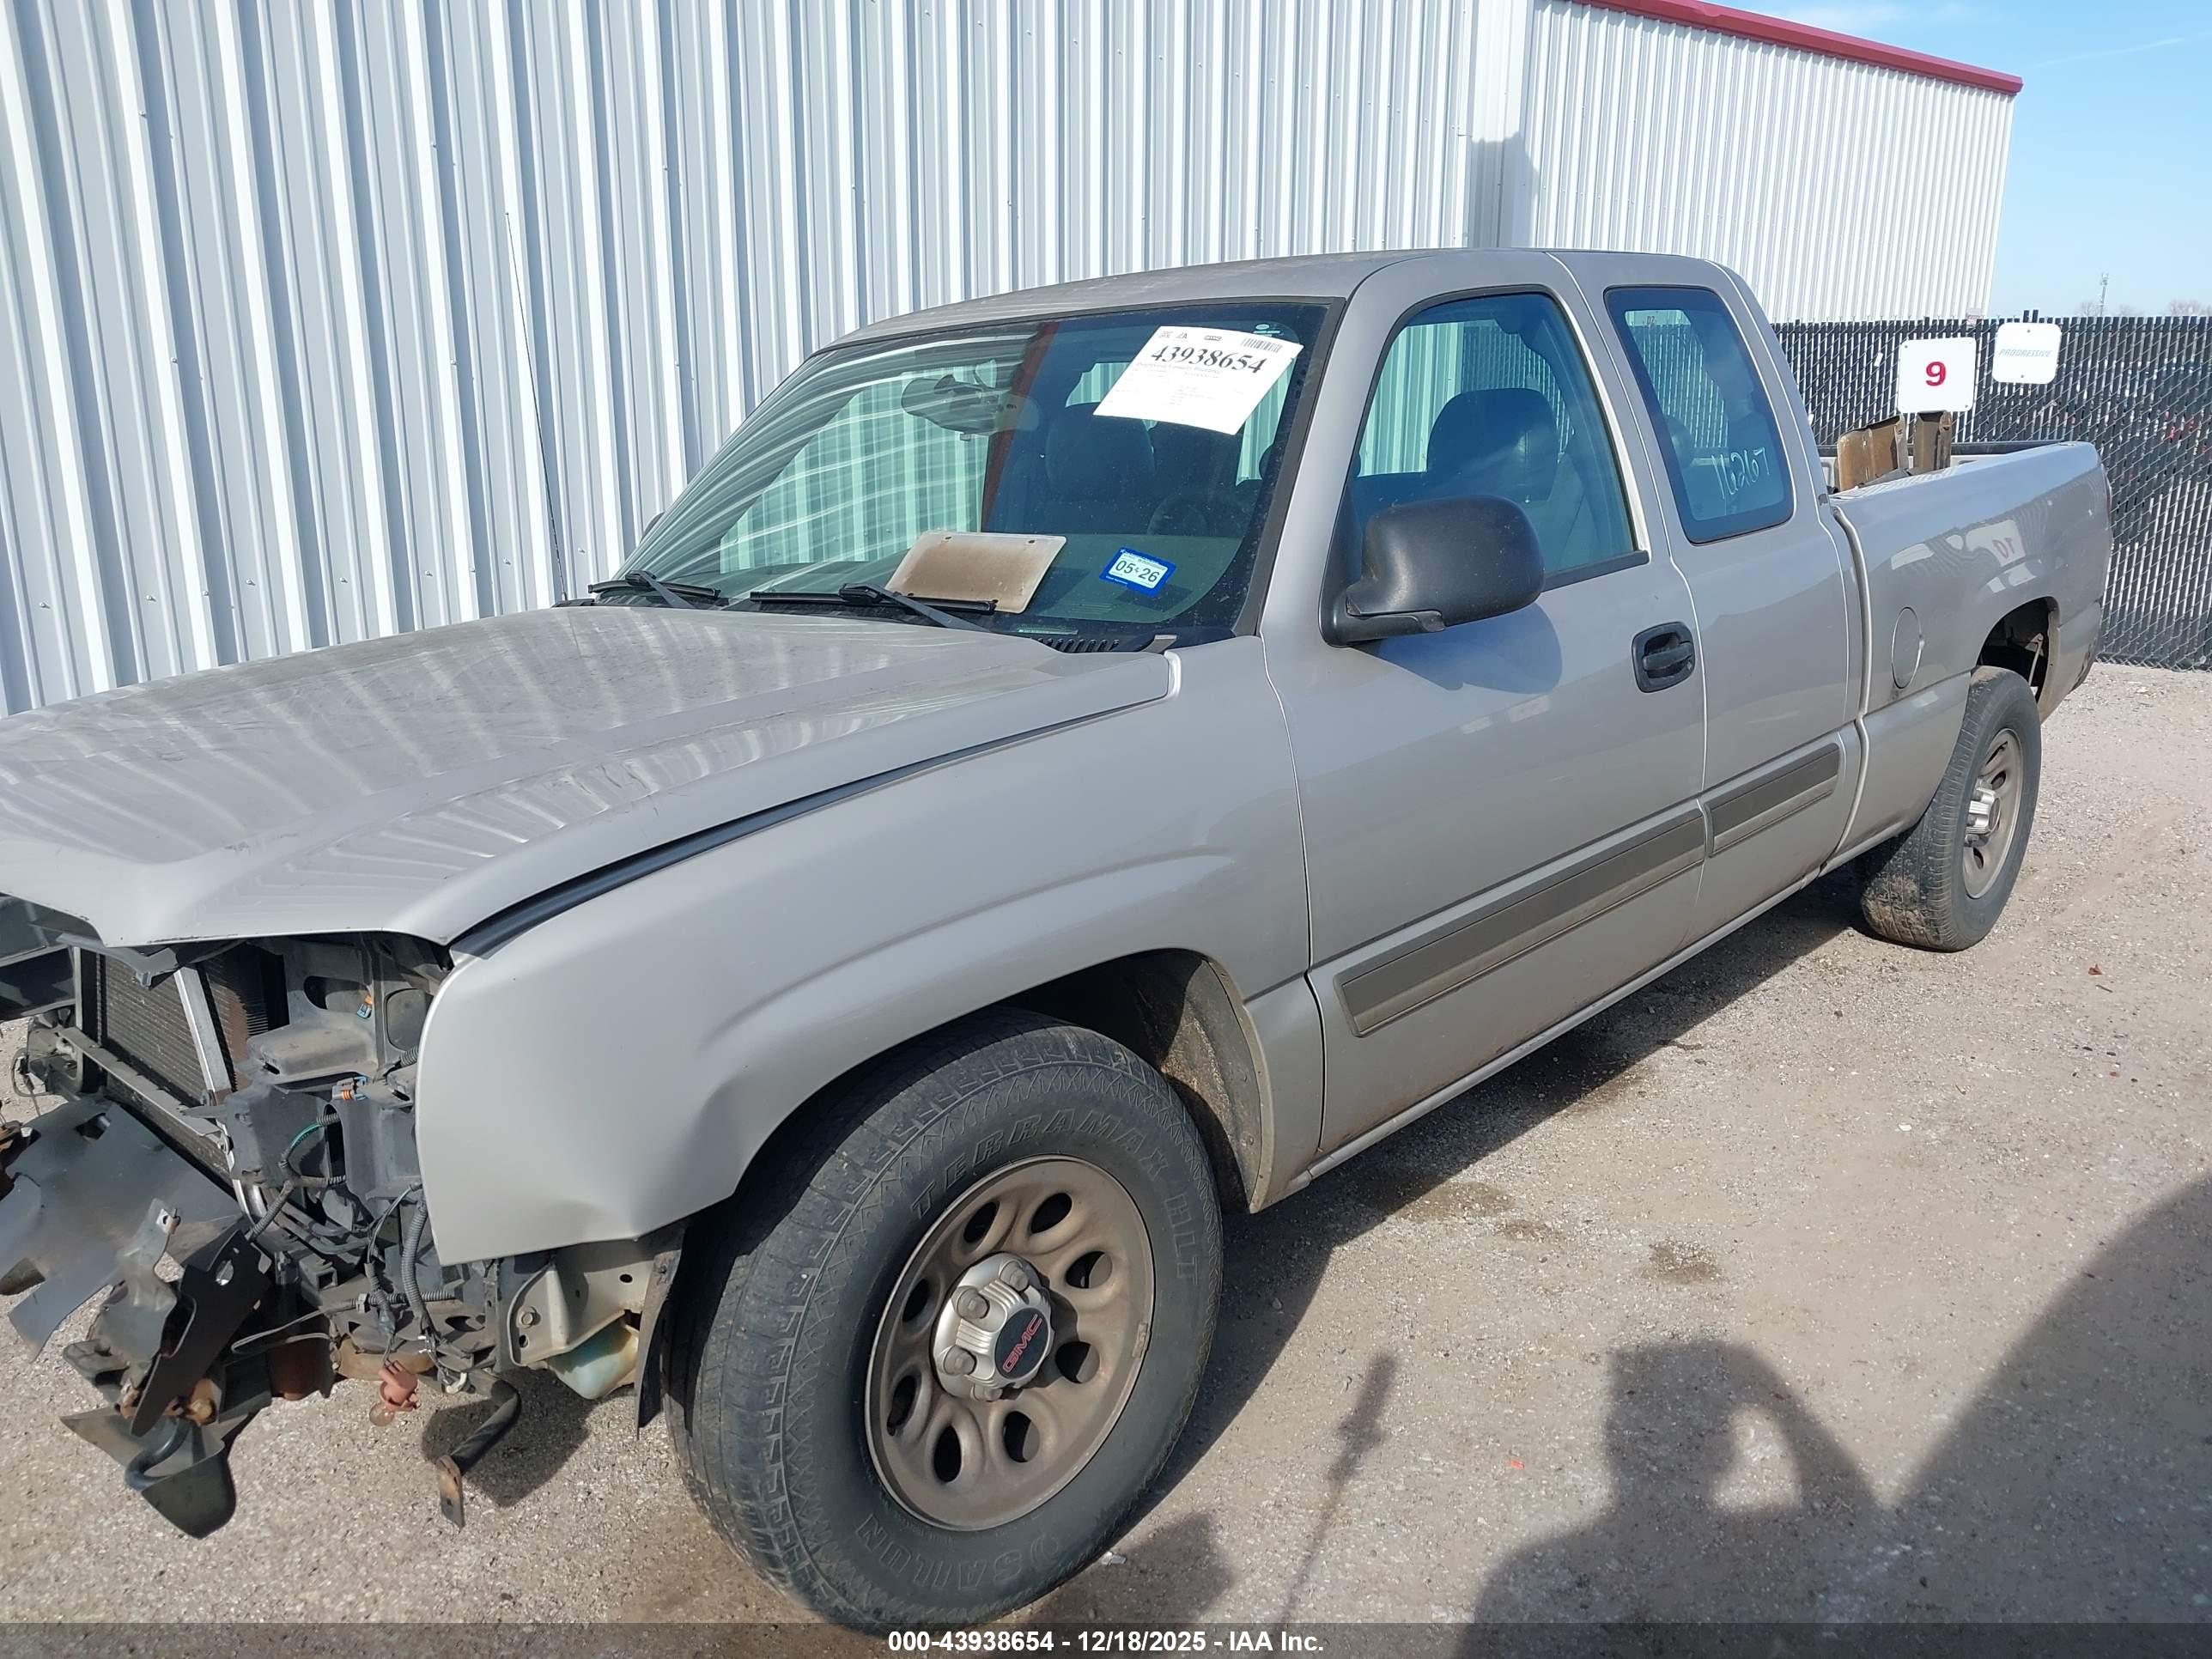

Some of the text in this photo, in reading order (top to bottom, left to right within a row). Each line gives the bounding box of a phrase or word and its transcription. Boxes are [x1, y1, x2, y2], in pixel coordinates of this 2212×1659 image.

[1152, 345, 1267, 374] 43938654
[1999, 349, 2053, 357] PROGRESSIVE
[1925, 362, 1947, 386] 9
[1115, 560, 1136, 574] 05
[1138, 568, 1160, 582] 26
[910, 1108, 1200, 1285] TERRAMAX HLT
[1003, 1313, 1042, 1373] GMC
[855, 1513, 1024, 1591] SAILUN
